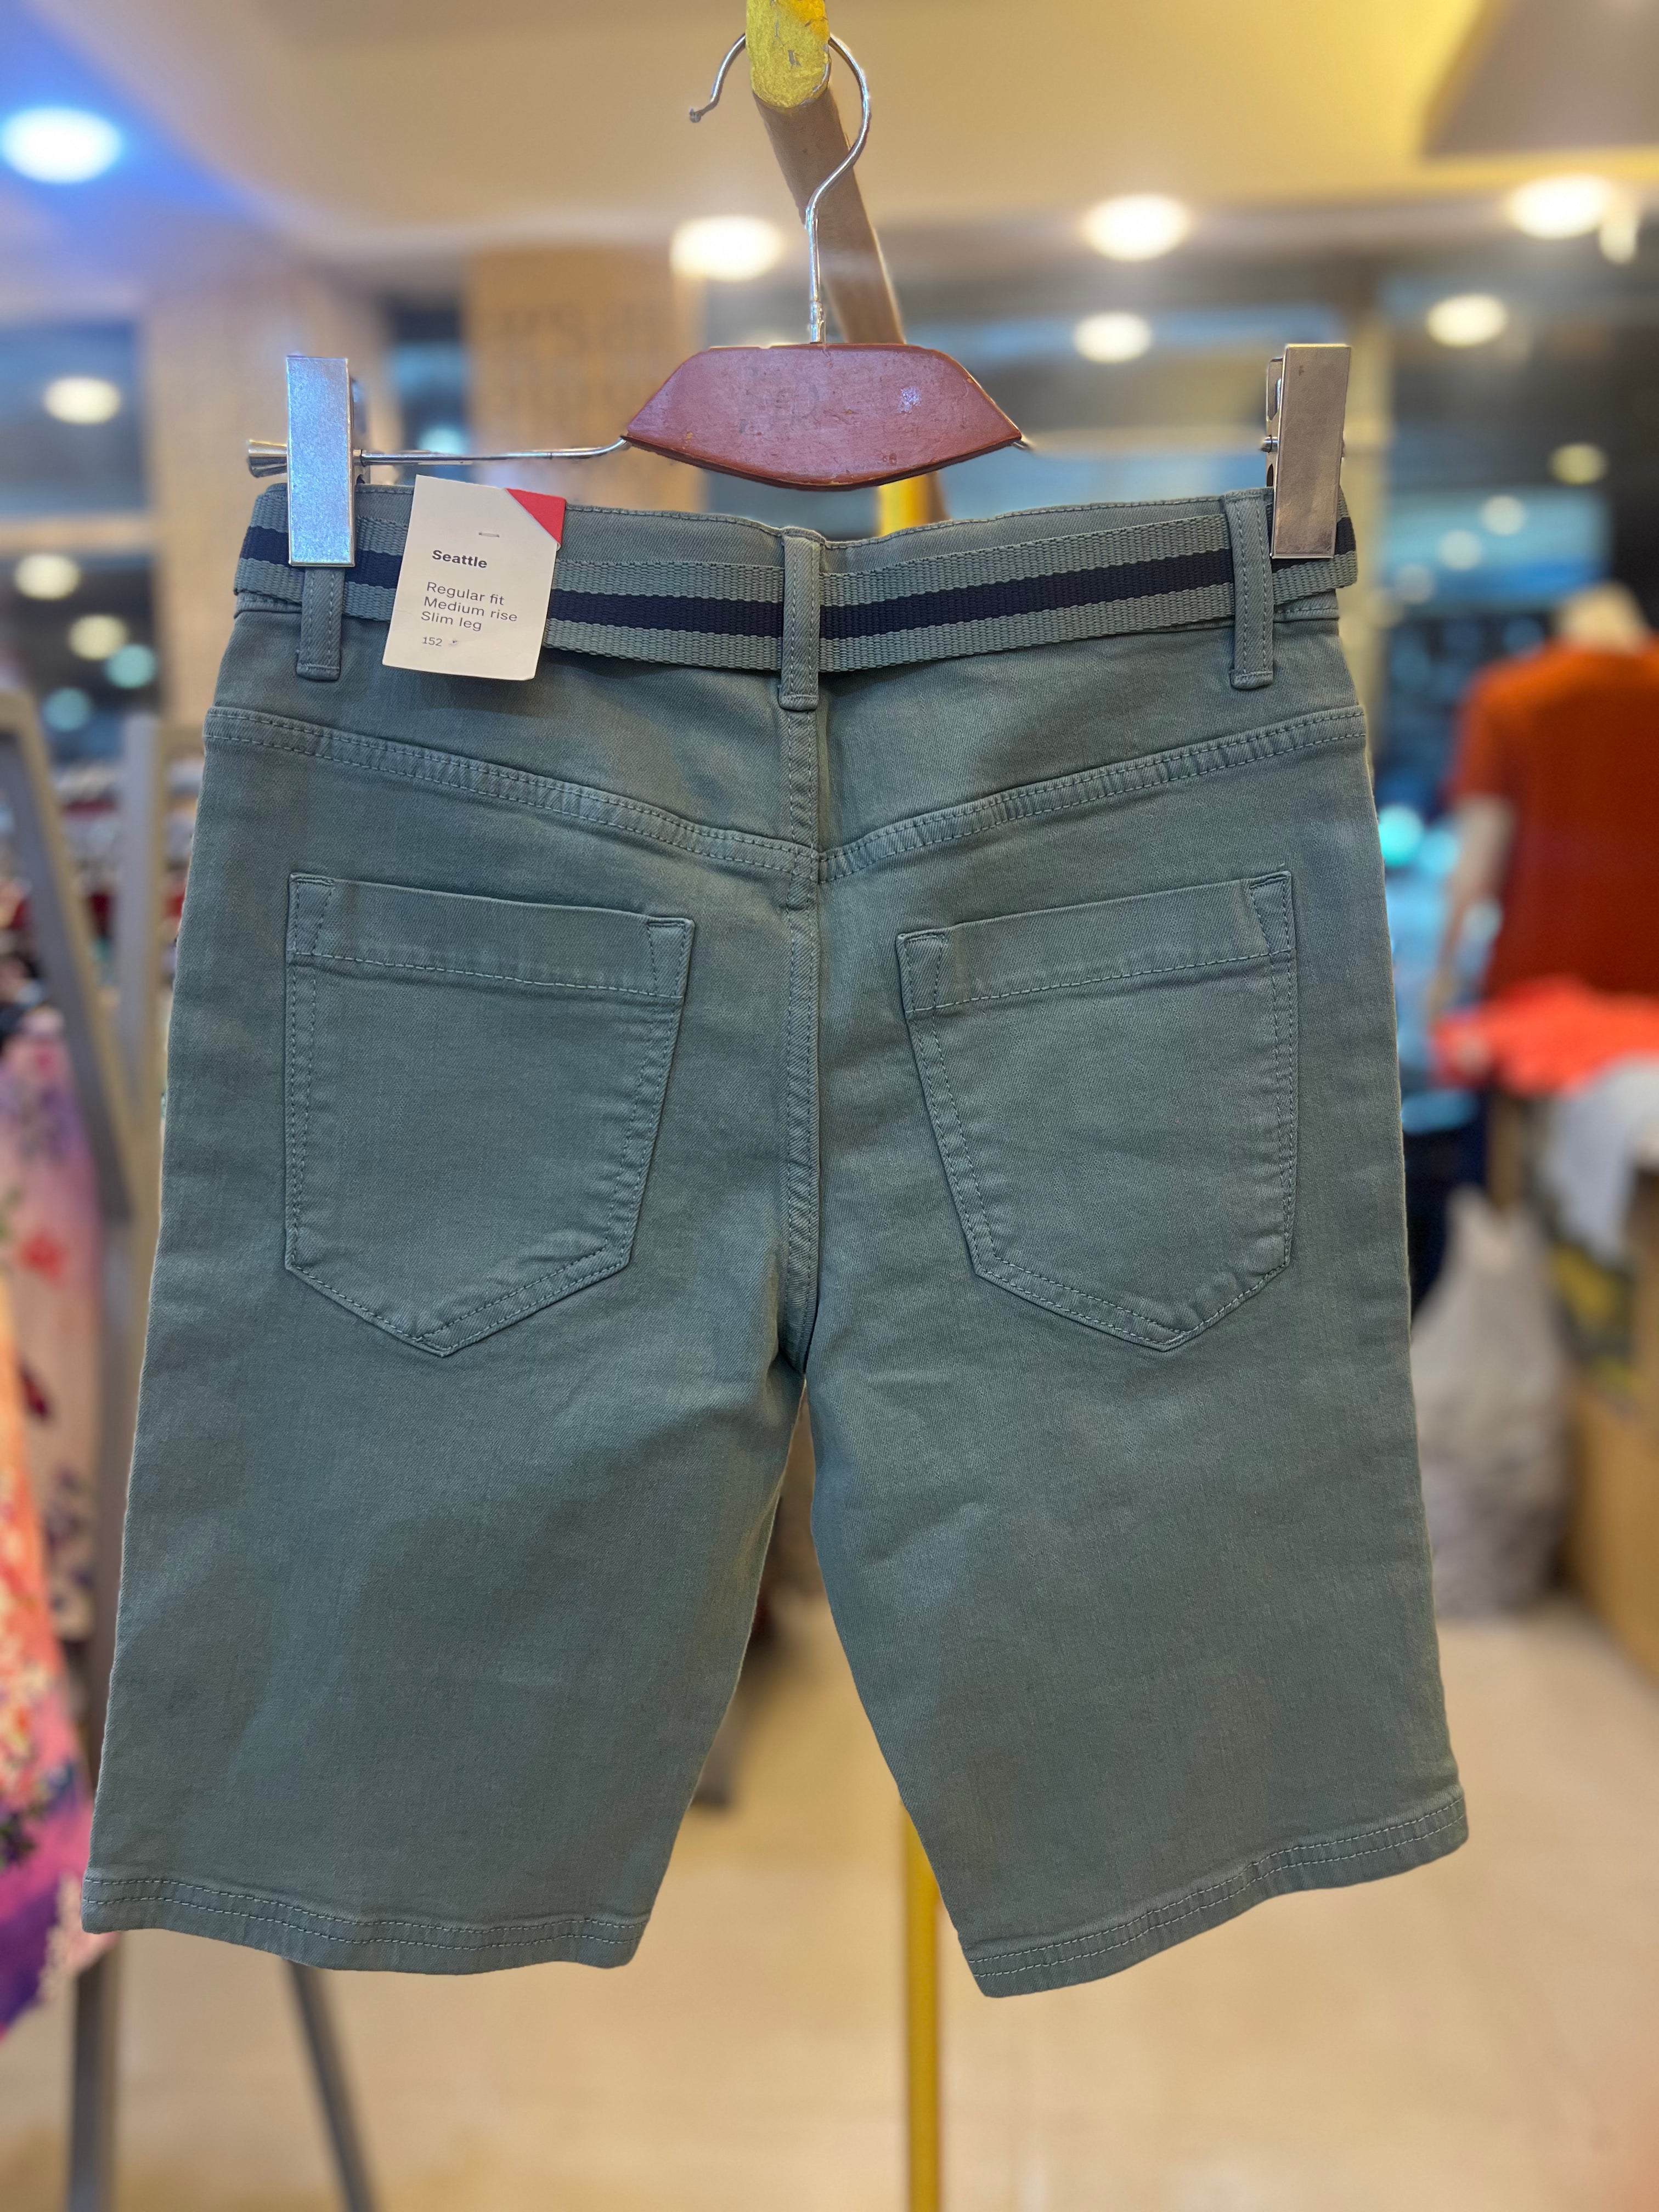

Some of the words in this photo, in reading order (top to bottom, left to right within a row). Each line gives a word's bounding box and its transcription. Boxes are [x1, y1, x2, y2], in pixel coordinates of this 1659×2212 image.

[432, 550, 488, 568] Seattle
[426, 582, 486, 602] Regular
[489, 593, 505, 606] fit
[424, 596, 484, 616] Medium
[490, 608, 517, 622] rise
[421, 611, 453, 625] Slim
[459, 617, 482, 631] leg
[422, 636, 443, 647] 152
